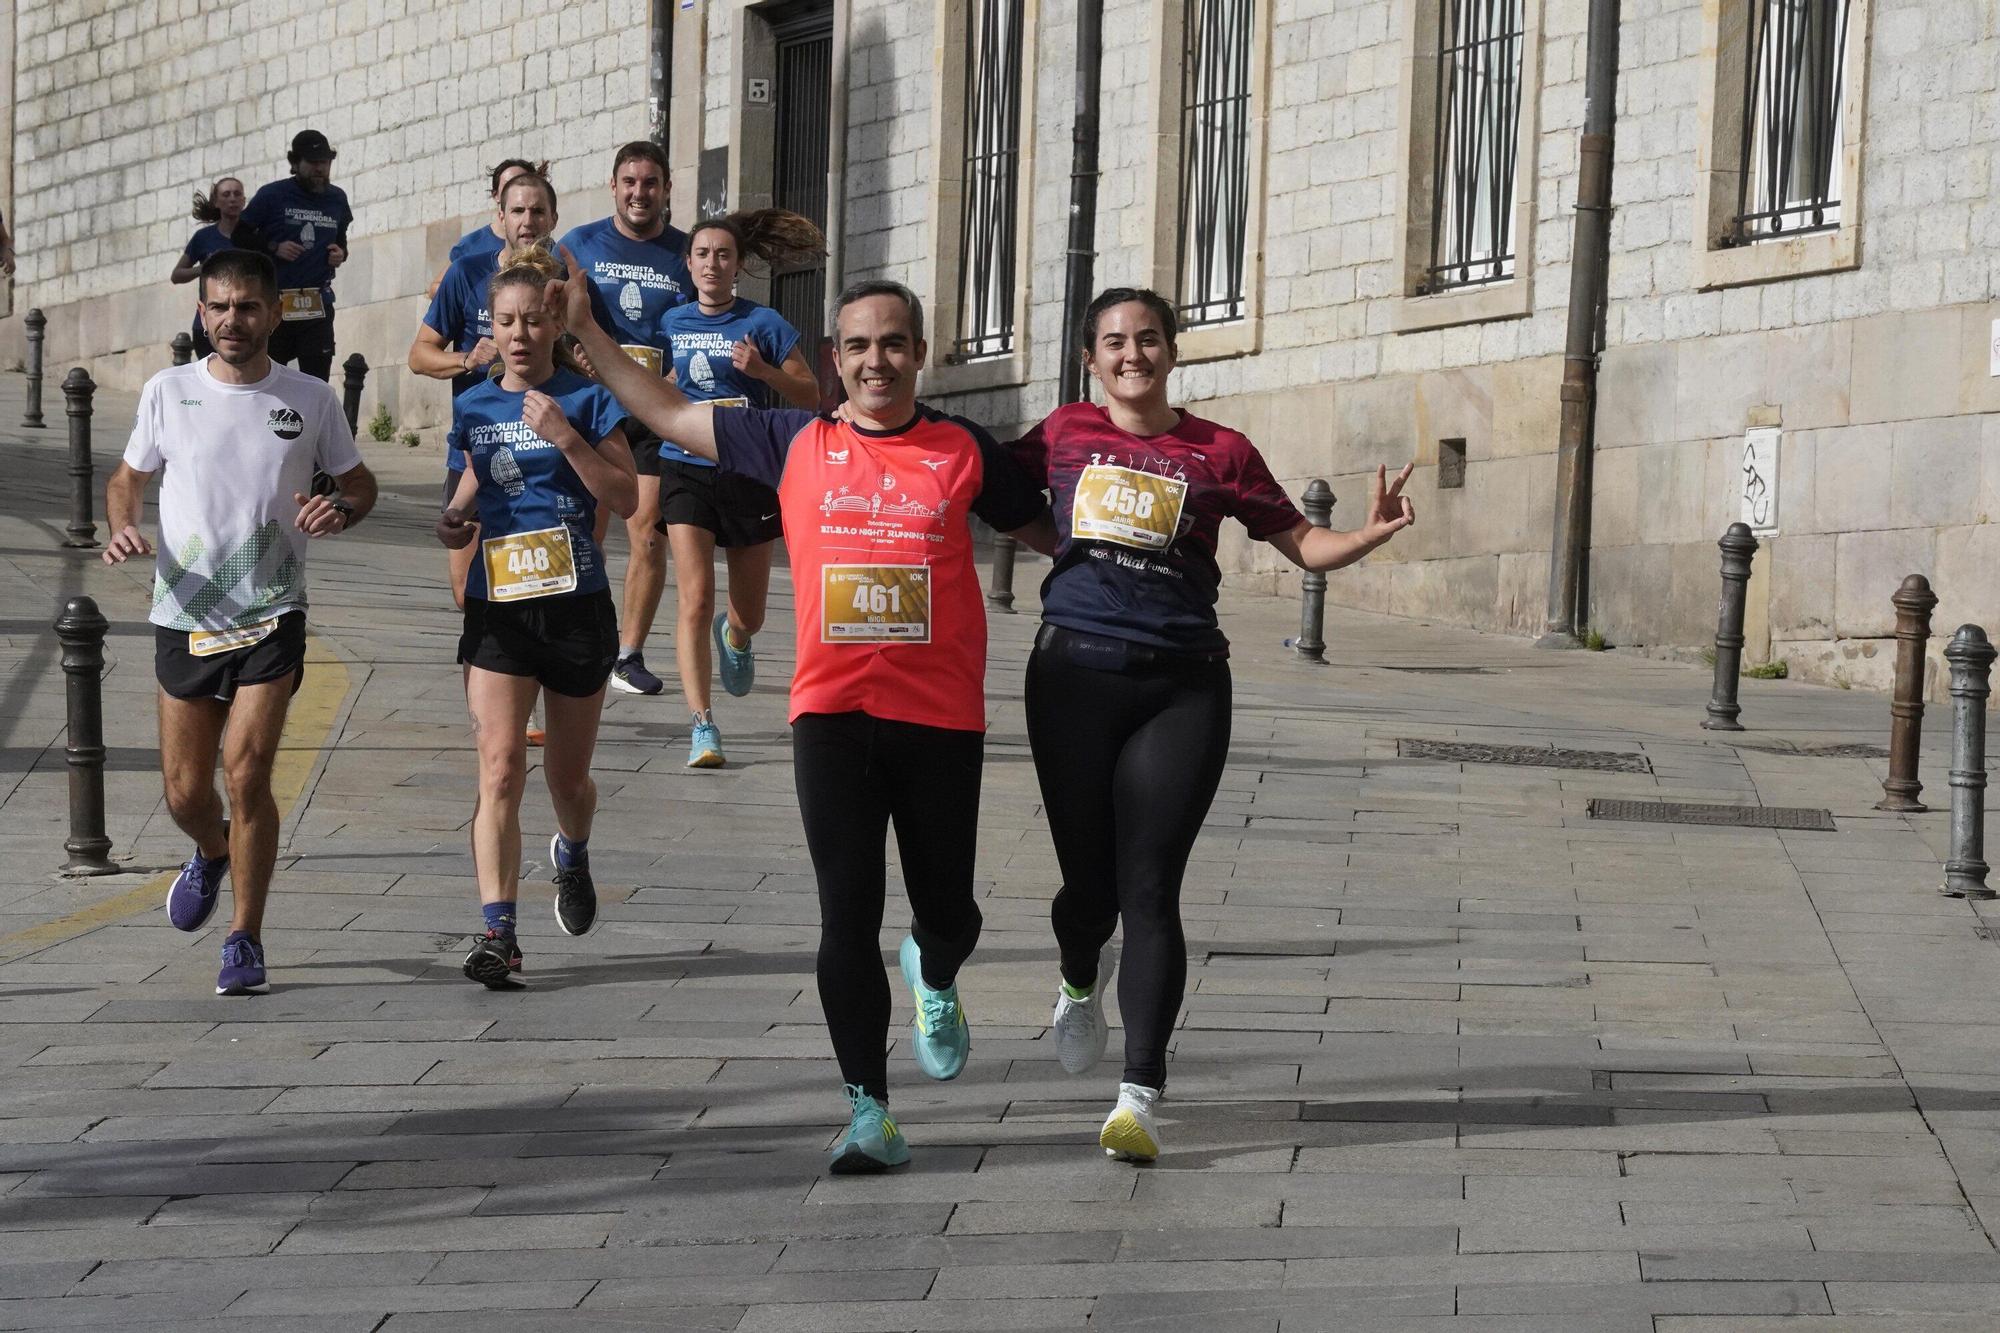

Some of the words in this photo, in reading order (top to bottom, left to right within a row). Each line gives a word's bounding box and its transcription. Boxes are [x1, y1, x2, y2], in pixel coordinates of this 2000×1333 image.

[753, 82, 765, 99] 5
[606, 262, 654, 273] CONQUISTA
[607, 270, 671, 284] ALMENDRA
[641, 280, 680, 293] KONKISTA
[677, 333, 723, 341] CONQUISTA
[678, 340, 734, 349] ALMENDR
[1165, 486, 1179, 494] 10K
[1100, 485, 1154, 519] 458
[867, 520, 903, 529] TotalEnergies
[552, 533, 564, 541] 10K
[821, 525, 857, 535] BILBAO
[859, 529, 885, 538] NIGHT
[887, 531, 925, 540] RUNNING
[508, 547, 549, 574] 448
[910, 573, 924, 581] 10K
[852, 584, 900, 613] 461
